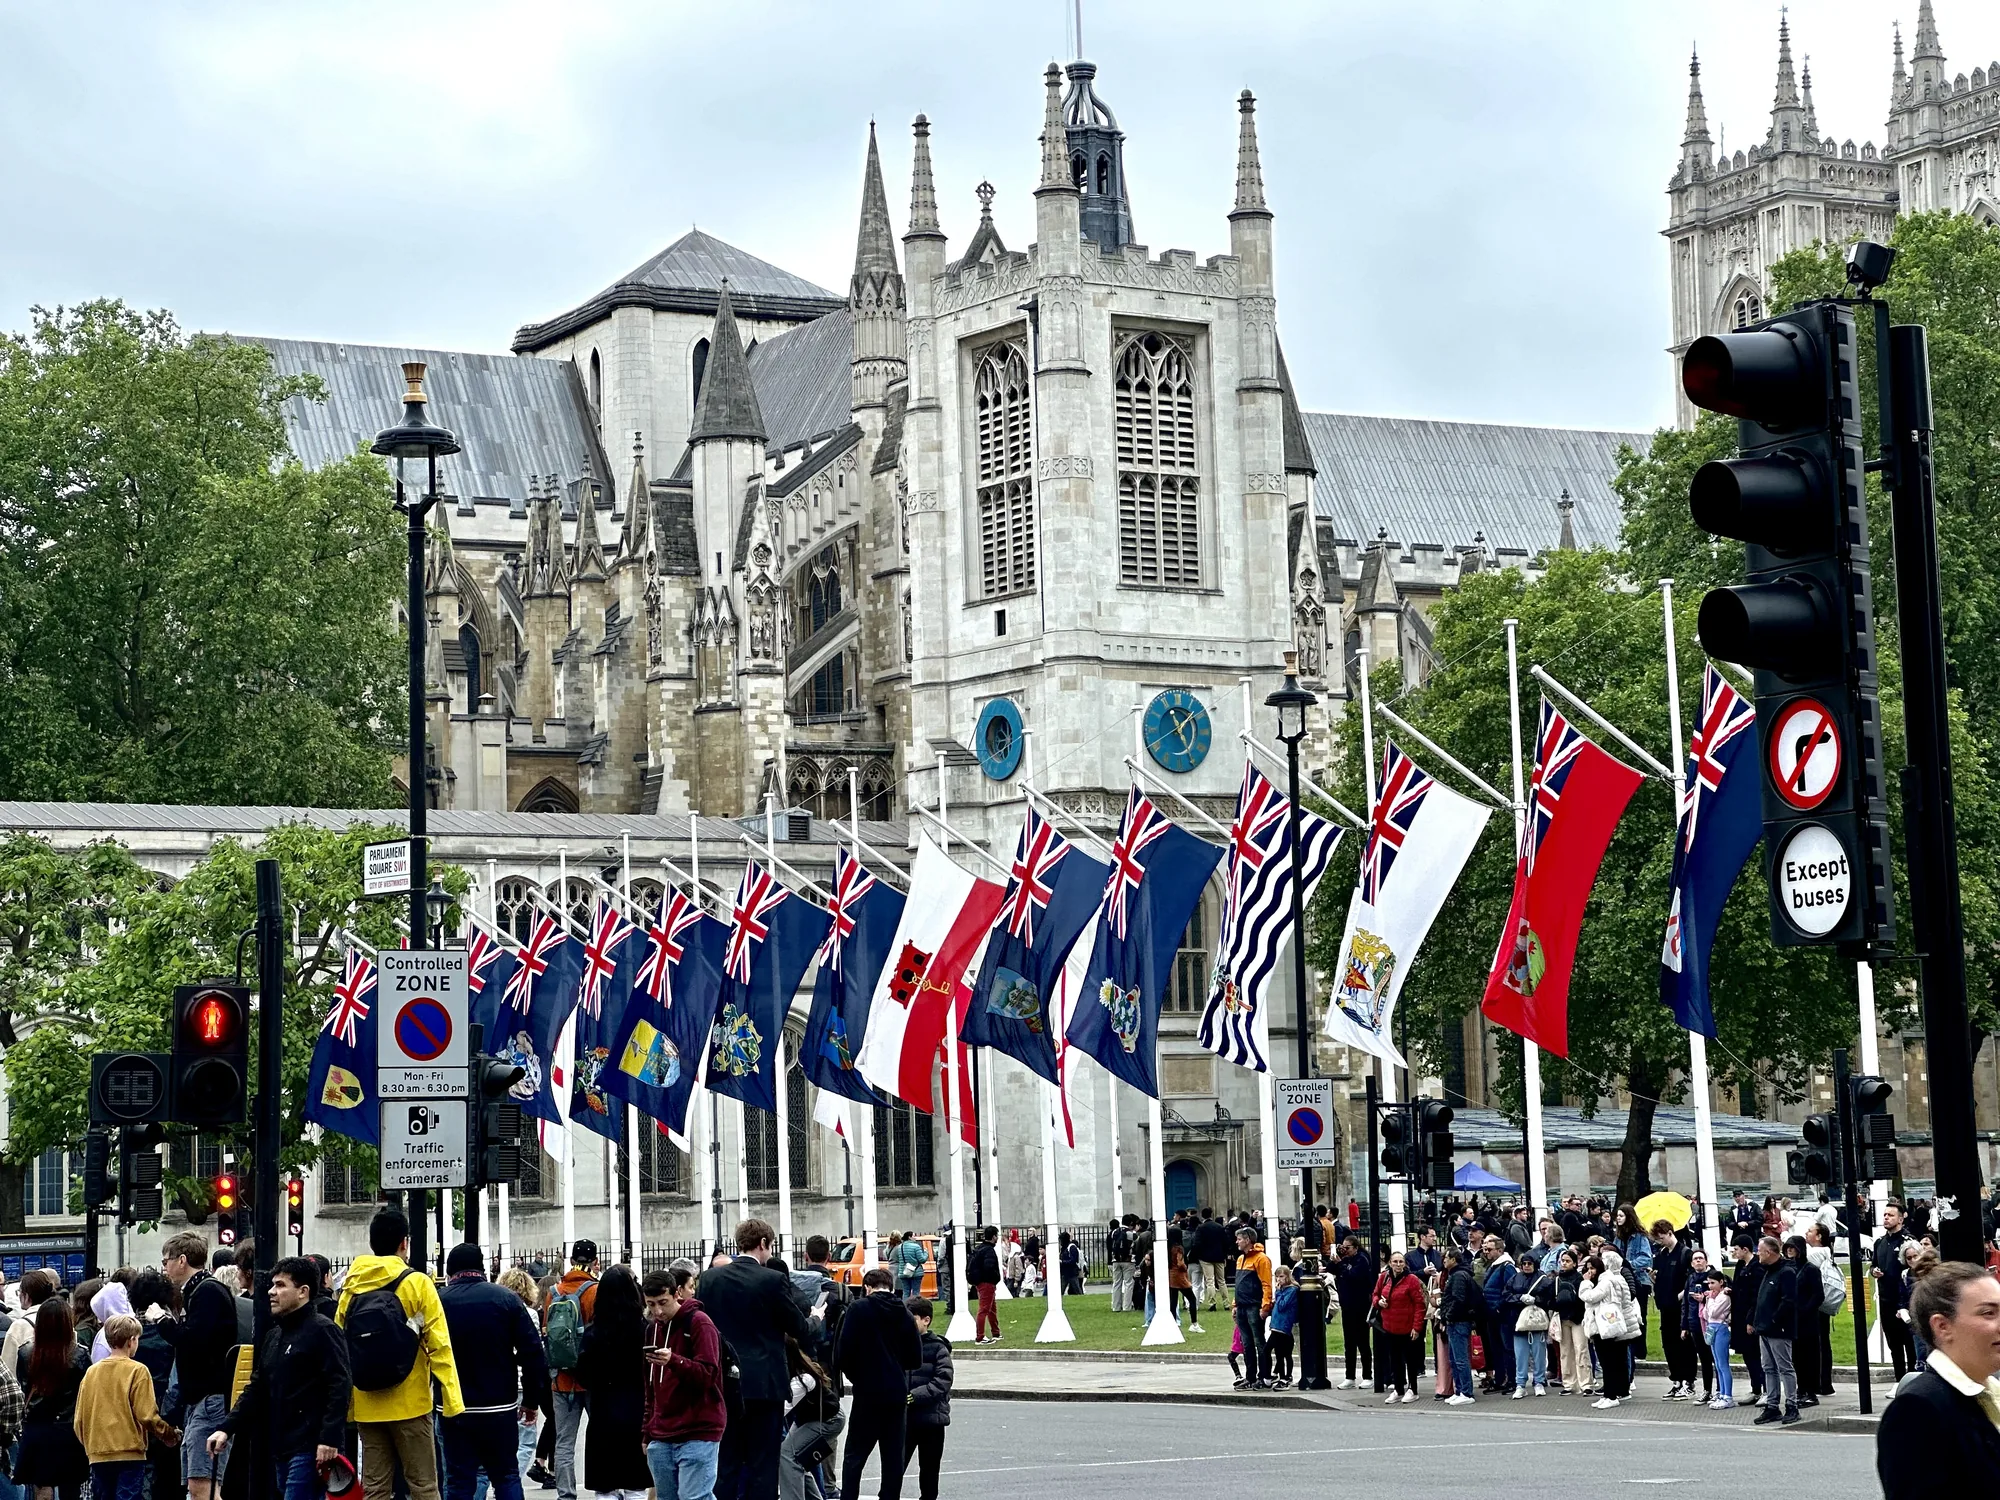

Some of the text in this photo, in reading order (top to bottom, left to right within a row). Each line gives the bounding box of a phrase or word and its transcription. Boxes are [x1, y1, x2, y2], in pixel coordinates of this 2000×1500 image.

[370, 846, 406, 861] PARLIAMENT
[369, 860, 407, 875] SQUARE SW1
[1786, 855, 1847, 882] Except
[384, 878, 409, 888] WESTMINSTER
[1793, 888, 1844, 909] buses
[385, 956, 463, 970] Controlled
[396, 975, 450, 991] ZONE
[404, 1072, 424, 1080] Mon
[431, 1072, 443, 1080] Fri
[382, 1084, 404, 1093] 8.30
[427, 1083, 449, 1092] 6.30
[451, 1085, 465, 1093] pm
[1280, 1083, 1328, 1091] Controlled
[1287, 1094, 1321, 1104] ZONE
[404, 1142, 444, 1153] Traffic
[385, 1157, 462, 1169] enforcement
[398, 1174, 449, 1184] cameras
